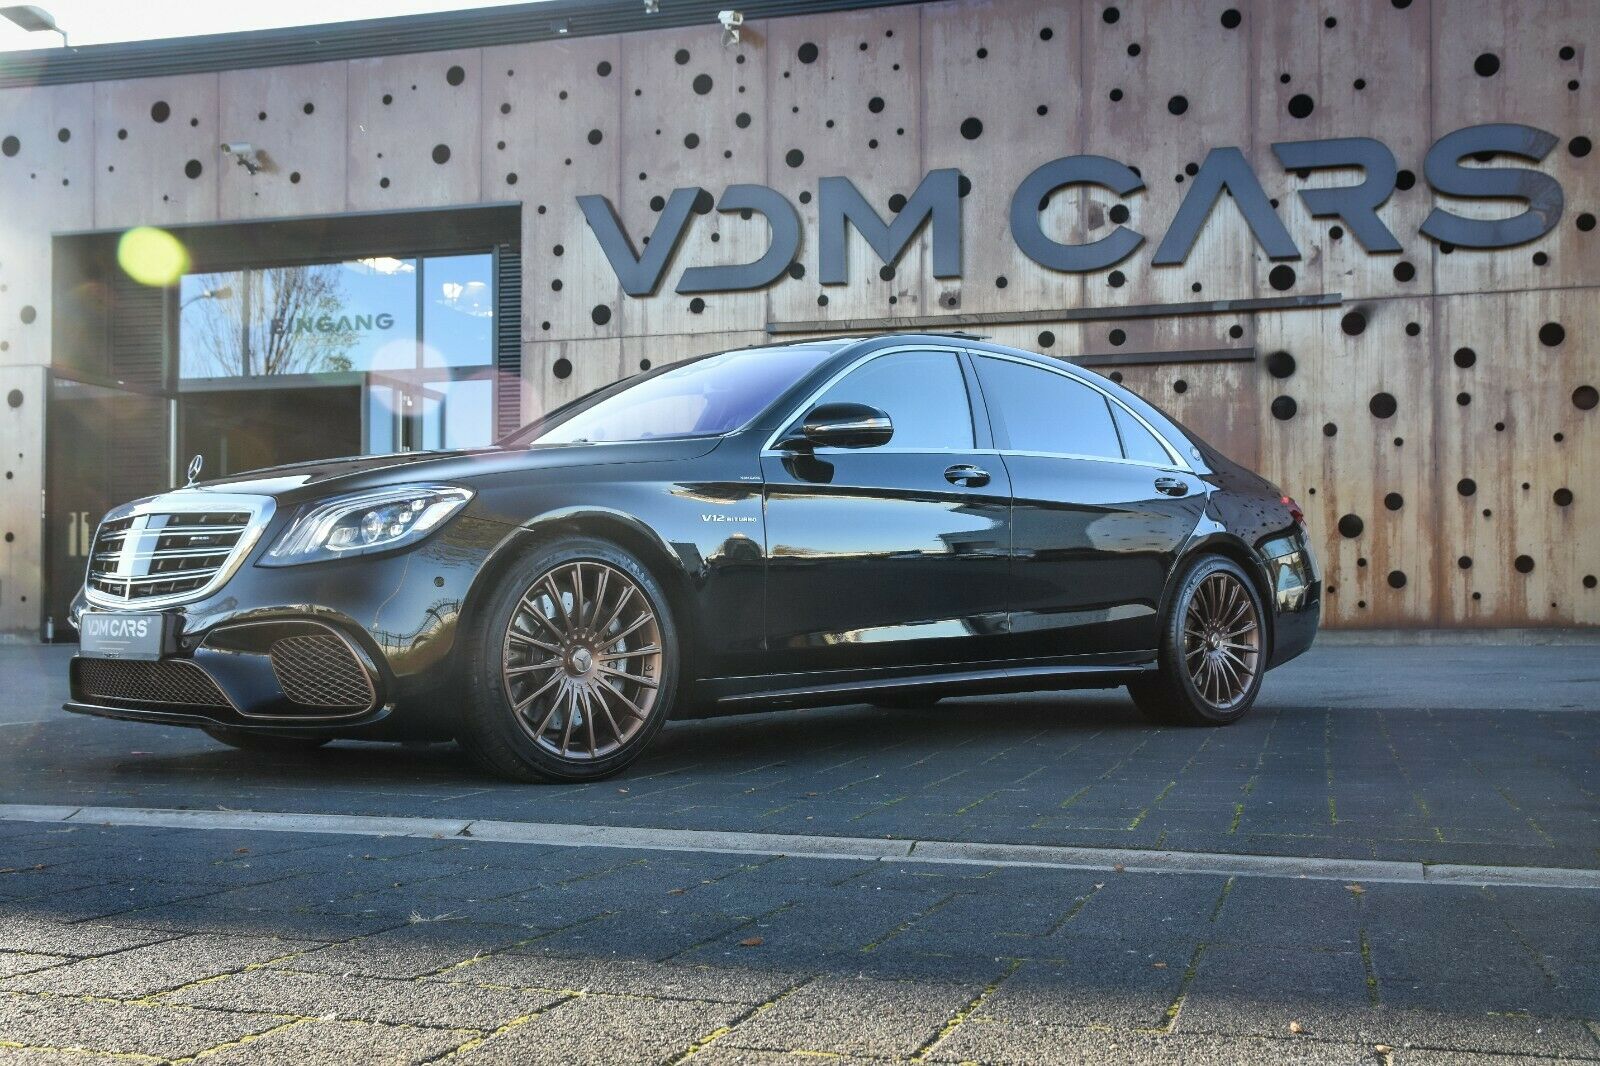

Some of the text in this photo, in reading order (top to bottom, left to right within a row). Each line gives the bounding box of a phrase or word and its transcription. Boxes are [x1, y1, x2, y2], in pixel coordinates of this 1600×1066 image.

[575, 123, 1565, 298] VDM CARS
[701, 514, 725, 522] V12
